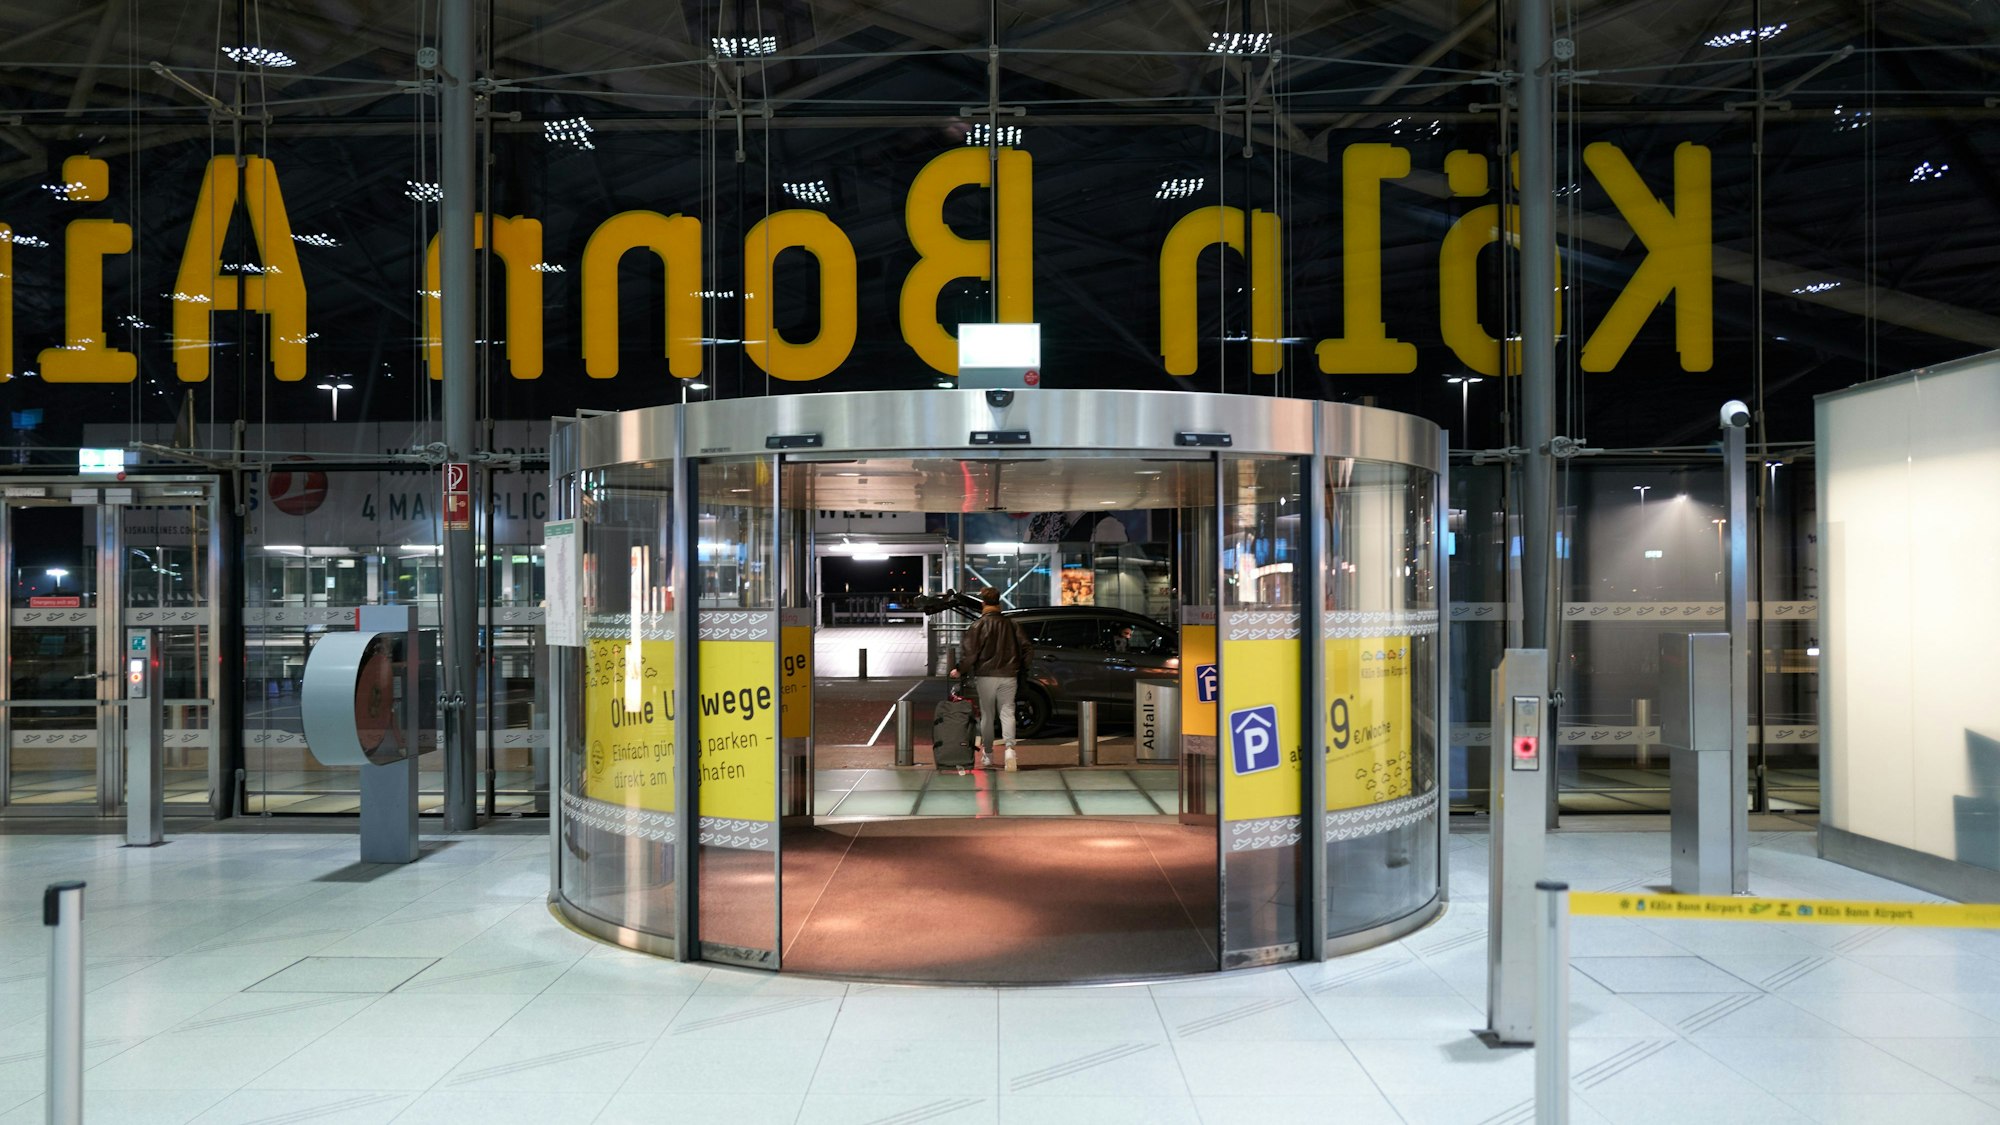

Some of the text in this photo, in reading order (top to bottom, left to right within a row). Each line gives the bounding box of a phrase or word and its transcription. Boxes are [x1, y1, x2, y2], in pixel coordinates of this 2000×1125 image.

[362, 493, 376, 521] 4
[390, 493, 432, 521] MA
[1143, 703, 1155, 750] Abfall
[613, 740, 650, 762] Einfach
[708, 731, 758, 757] parken
[614, 770, 646, 789] direkt
[650, 772, 667, 786] am
[1705, 902, 1744, 915] Airport
[1874, 906, 1913, 920] Airport
